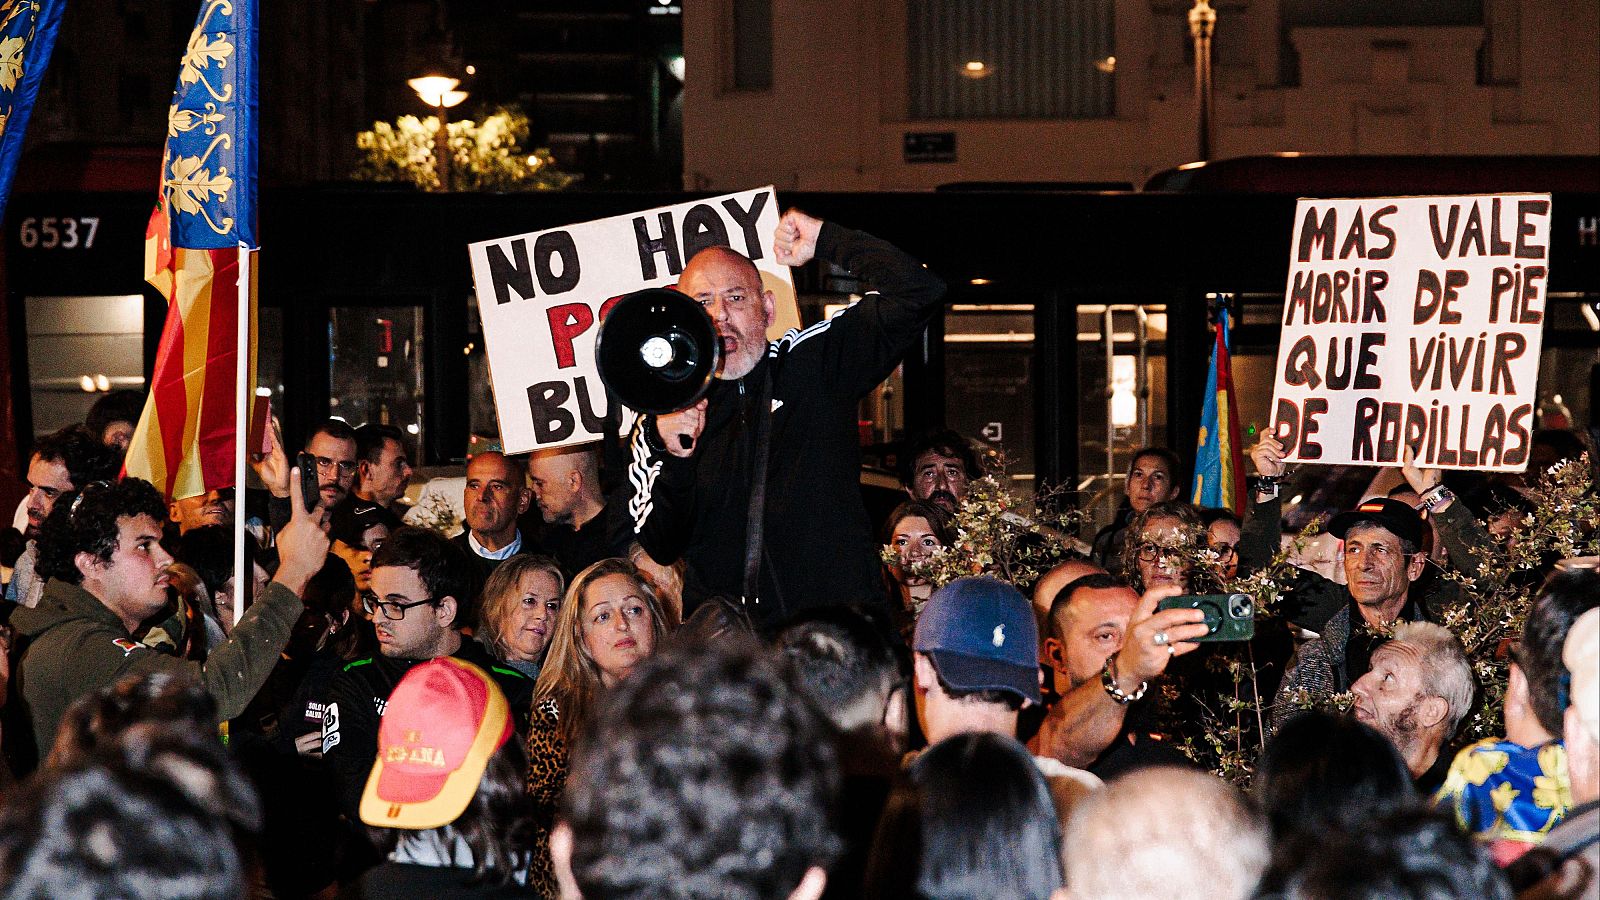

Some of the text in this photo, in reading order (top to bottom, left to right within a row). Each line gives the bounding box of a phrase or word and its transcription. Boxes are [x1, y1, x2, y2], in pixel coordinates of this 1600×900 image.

[20, 217, 99, 249] 6537
[485, 191, 771, 305] NO HAY
[1297, 198, 1550, 263] MAS VALE
[1413, 269, 1469, 325] DE
[1284, 332, 1386, 391] QUE
[1275, 397, 1329, 460] DE
